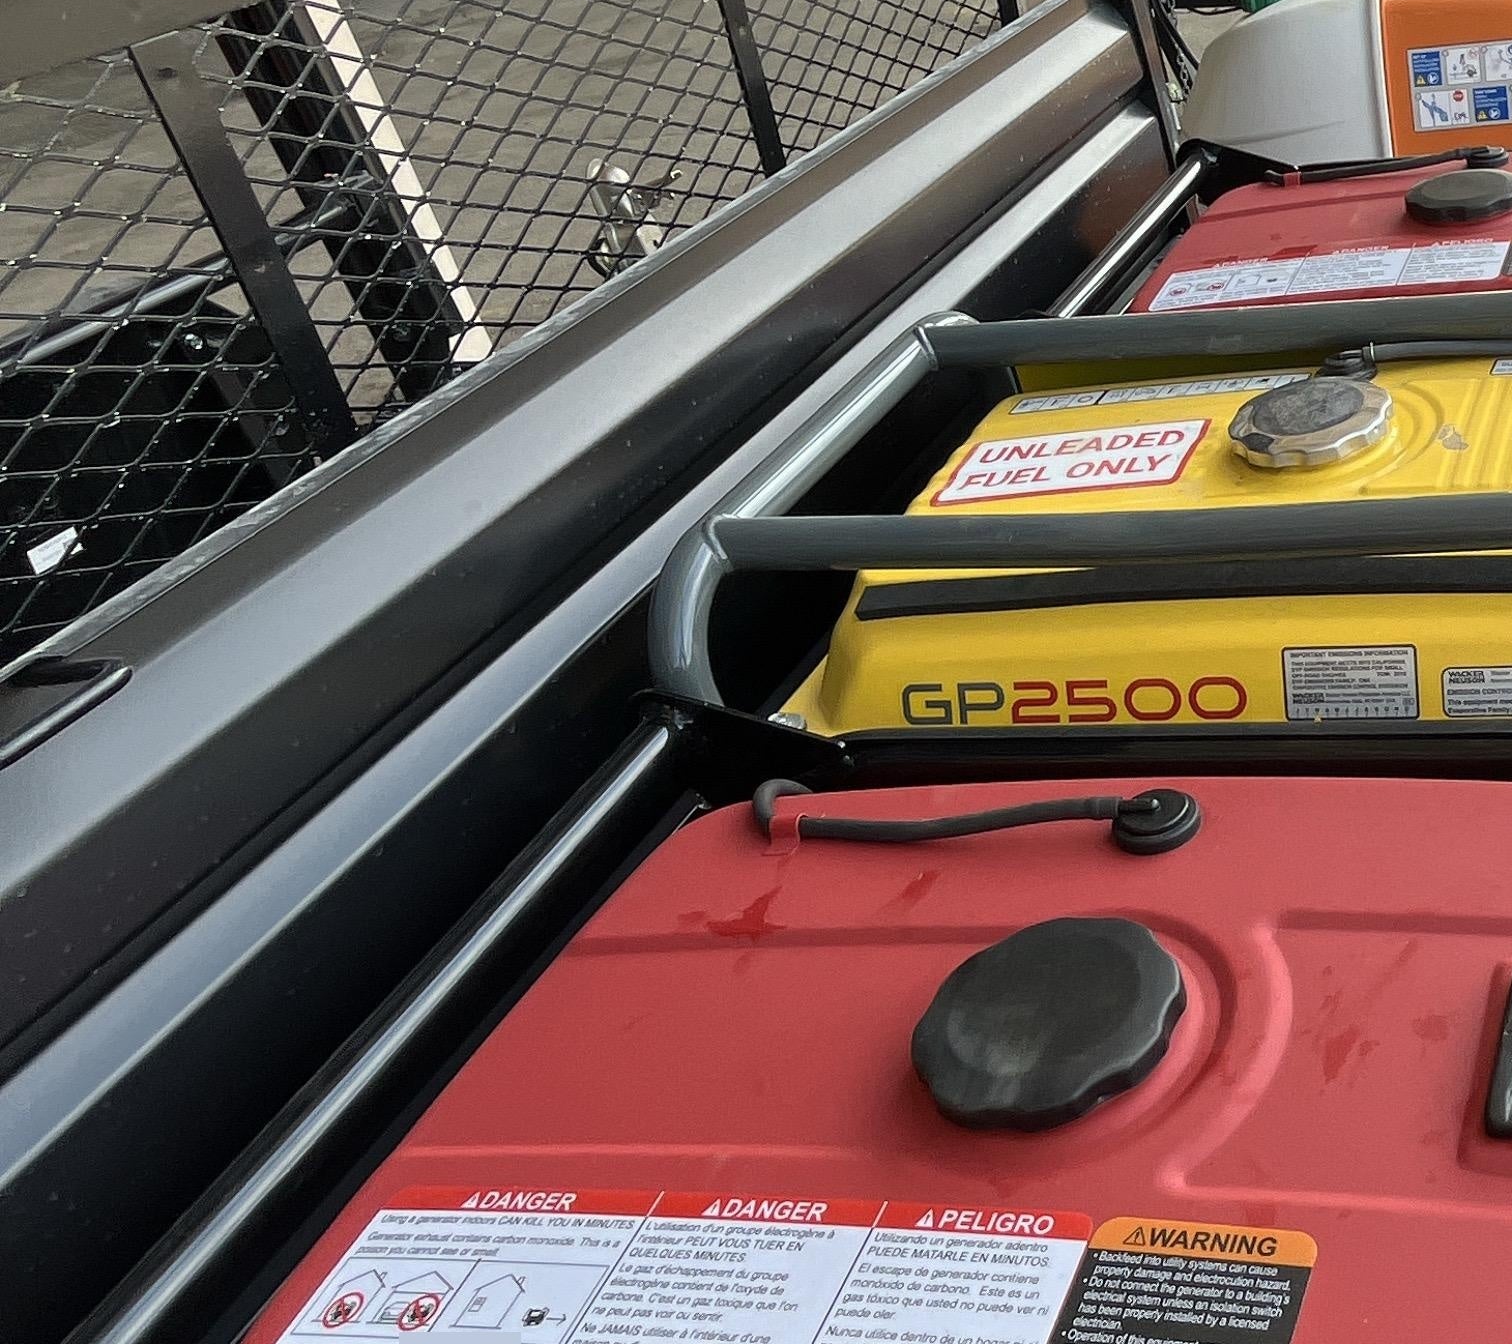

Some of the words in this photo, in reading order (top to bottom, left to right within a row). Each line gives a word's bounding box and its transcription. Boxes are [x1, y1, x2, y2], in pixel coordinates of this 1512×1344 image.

[979, 430, 1185, 464] UNLEADED
[958, 466, 1050, 489] FUEL
[1066, 454, 1172, 478] ONLY
[902, 676, 1247, 725] GP2500
[479, 1191, 577, 1211] DANGER
[721, 1199, 828, 1222] DANGER
[937, 1209, 1055, 1236] PELIGRO
[1150, 1228, 1277, 1257] WARNING
[1092, 1264, 1133, 1278] property
[1132, 1268, 1172, 1281] damage
[1173, 1271, 1192, 1281] and
[1255, 1278, 1292, 1290] hazard.
[1098, 1252, 1142, 1264] Backfeed
[1142, 1256, 1162, 1266] into
[1187, 1260, 1227, 1274] systems
[1247, 1267, 1277, 1276] cause
[1083, 1290, 1125, 1303] electrical
[1125, 1294, 1161, 1308] system
[1162, 1297, 1194, 1309] unless
[1209, 1301, 1250, 1314] isolation
[1251, 1305, 1283, 1317] switch
[1103, 1278, 1120, 1288] not
[1120, 1280, 1159, 1292] connect
[1159, 1283, 1176, 1293] the
[1176, 1285, 1223, 1299] generator
[1244, 1291, 1290, 1305] building's
[1072, 1315, 1124, 1329] electrician.
[1077, 1303, 1097, 1313] has
[1097, 1304, 1123, 1316] been
[1122, 1307, 1163, 1321] properly
[1163, 1311, 1203, 1323] installed
[1227, 1317, 1269, 1330] licensed
[1066, 1329, 1115, 1344] Operation
